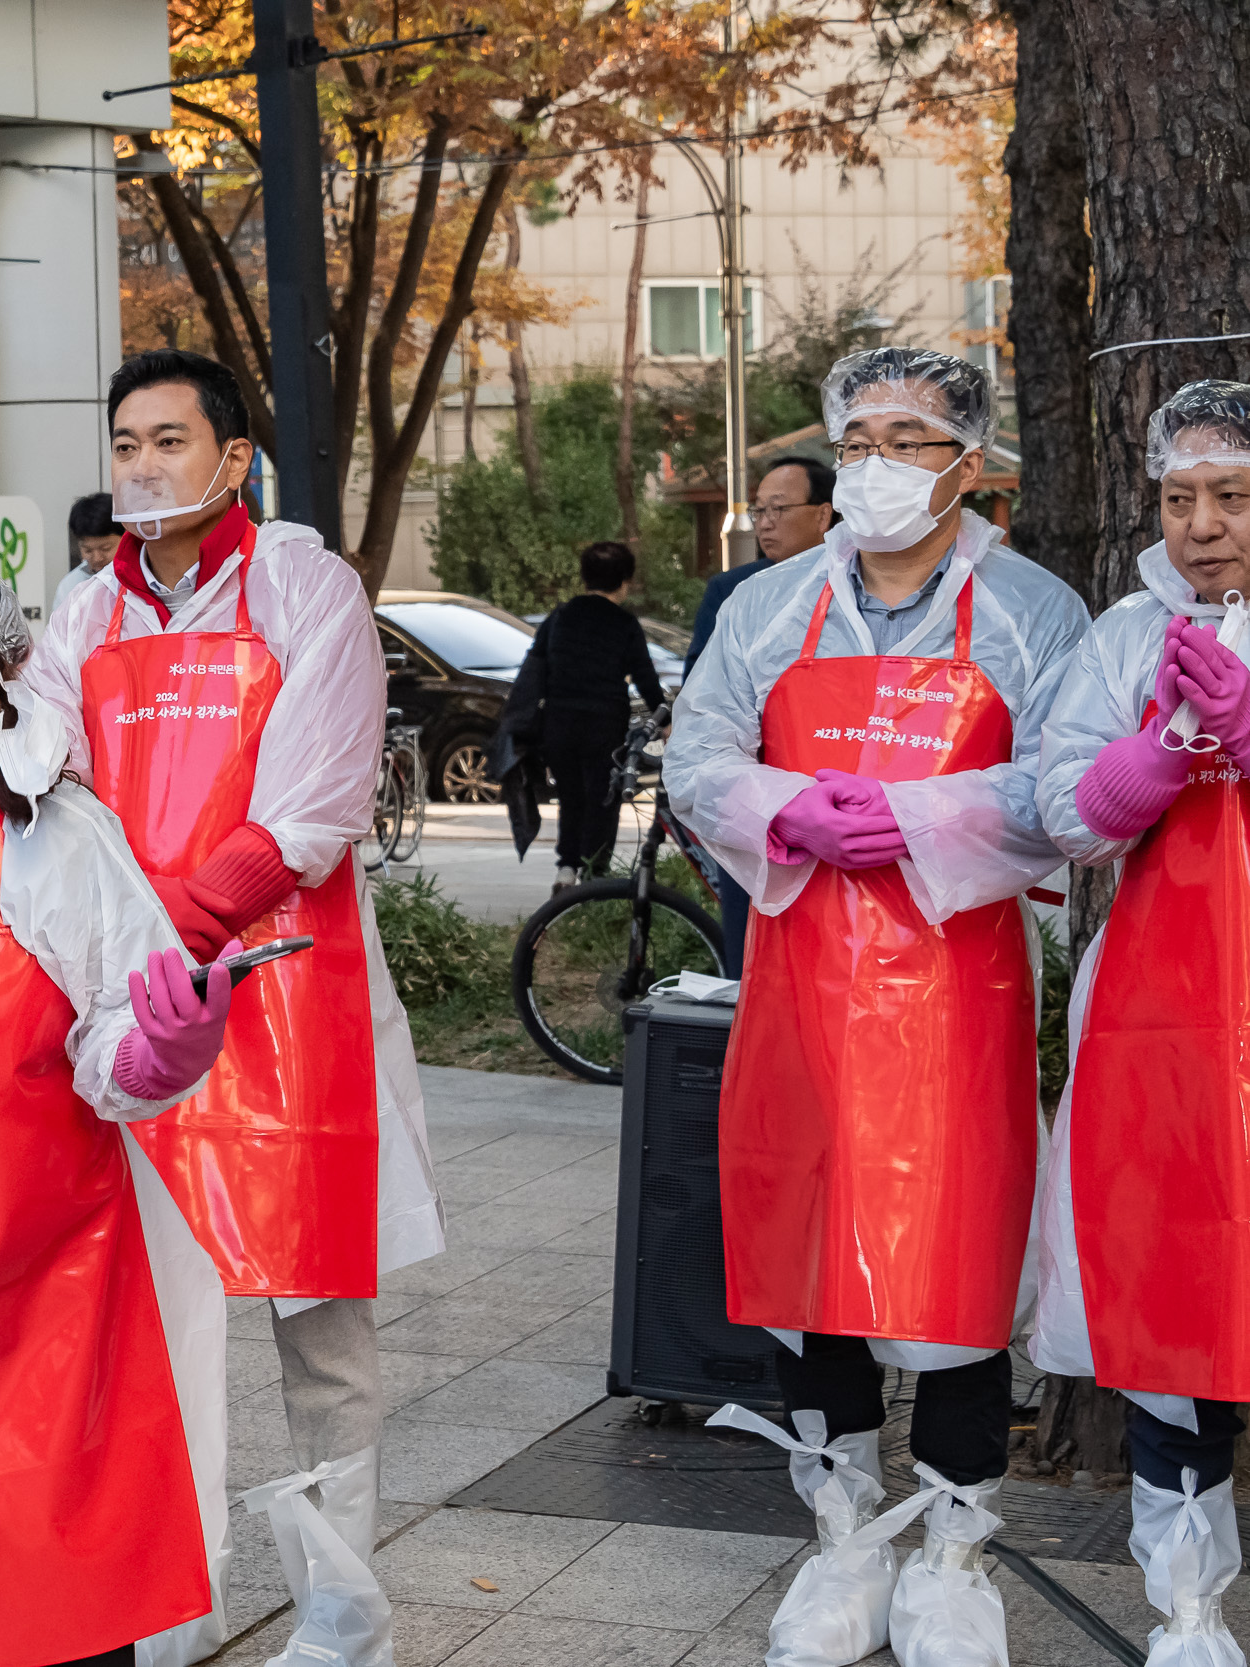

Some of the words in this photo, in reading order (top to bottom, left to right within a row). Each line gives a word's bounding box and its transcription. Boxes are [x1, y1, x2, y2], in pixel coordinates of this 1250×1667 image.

[156, 692, 178, 702] 2024
[157, 705, 191, 720] 사랑의
[868, 716, 893, 727] 2024
[813, 728, 841, 740] 제2회
[844, 727, 866, 742] 광진
[868, 730, 906, 746] 사랑의
